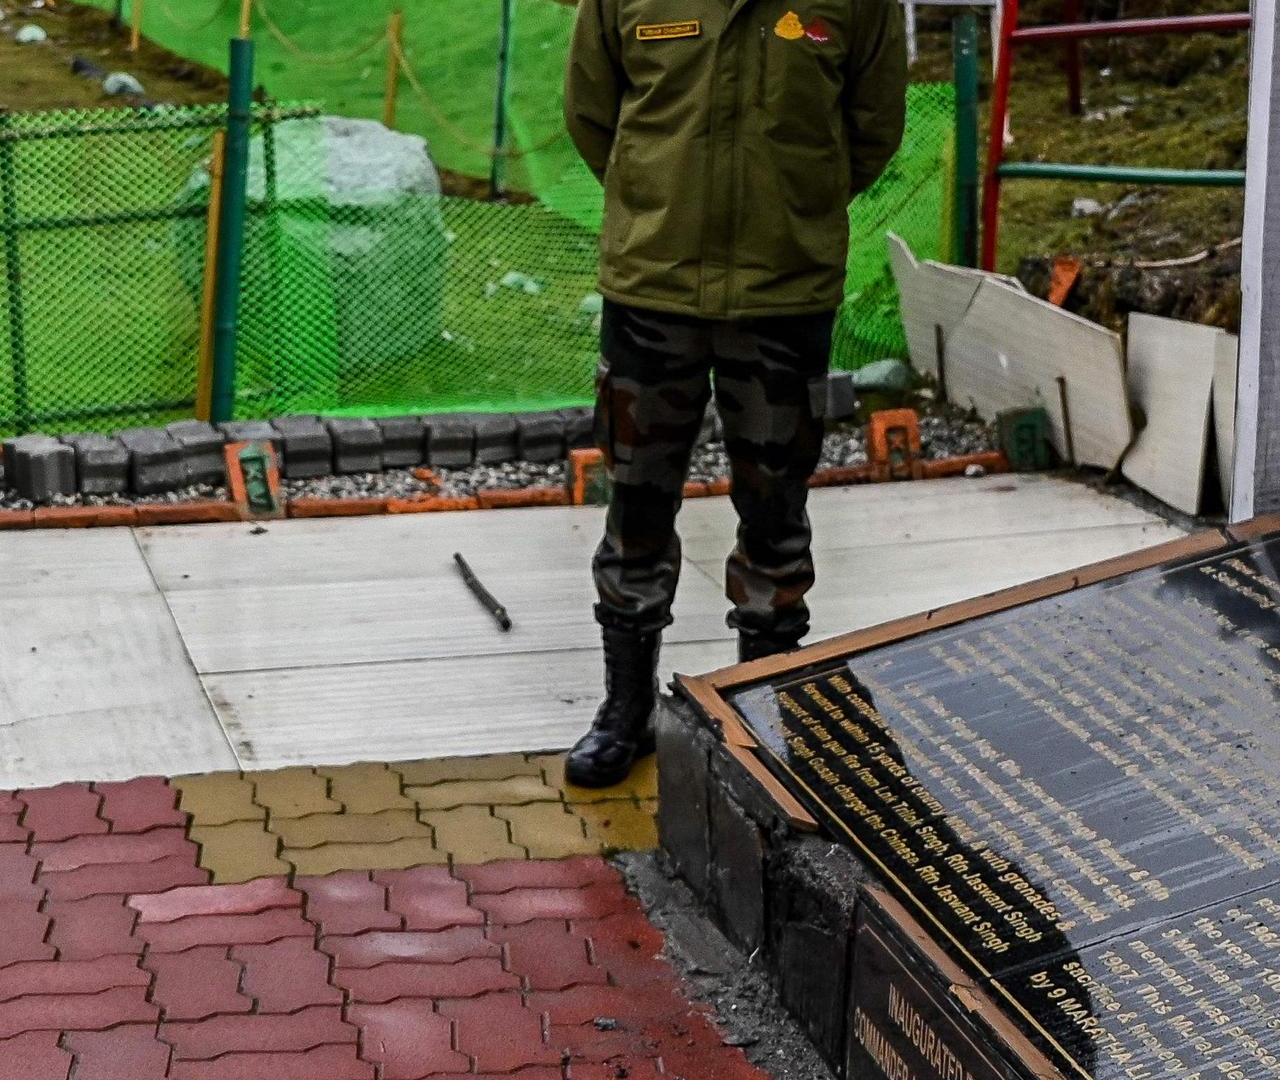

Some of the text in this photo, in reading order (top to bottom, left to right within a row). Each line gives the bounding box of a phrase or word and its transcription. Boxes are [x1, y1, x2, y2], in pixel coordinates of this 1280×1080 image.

[833, 783, 1011, 953] charged the Chinese. Rfn Jaswant Singh
[873, 785, 1043, 943] Lnk Trilok Singh, Rfn Jaswant Singh
[979, 848, 1064, 921] with grenades
[1029, 970, 1132, 1066] by 9 MARATHA
